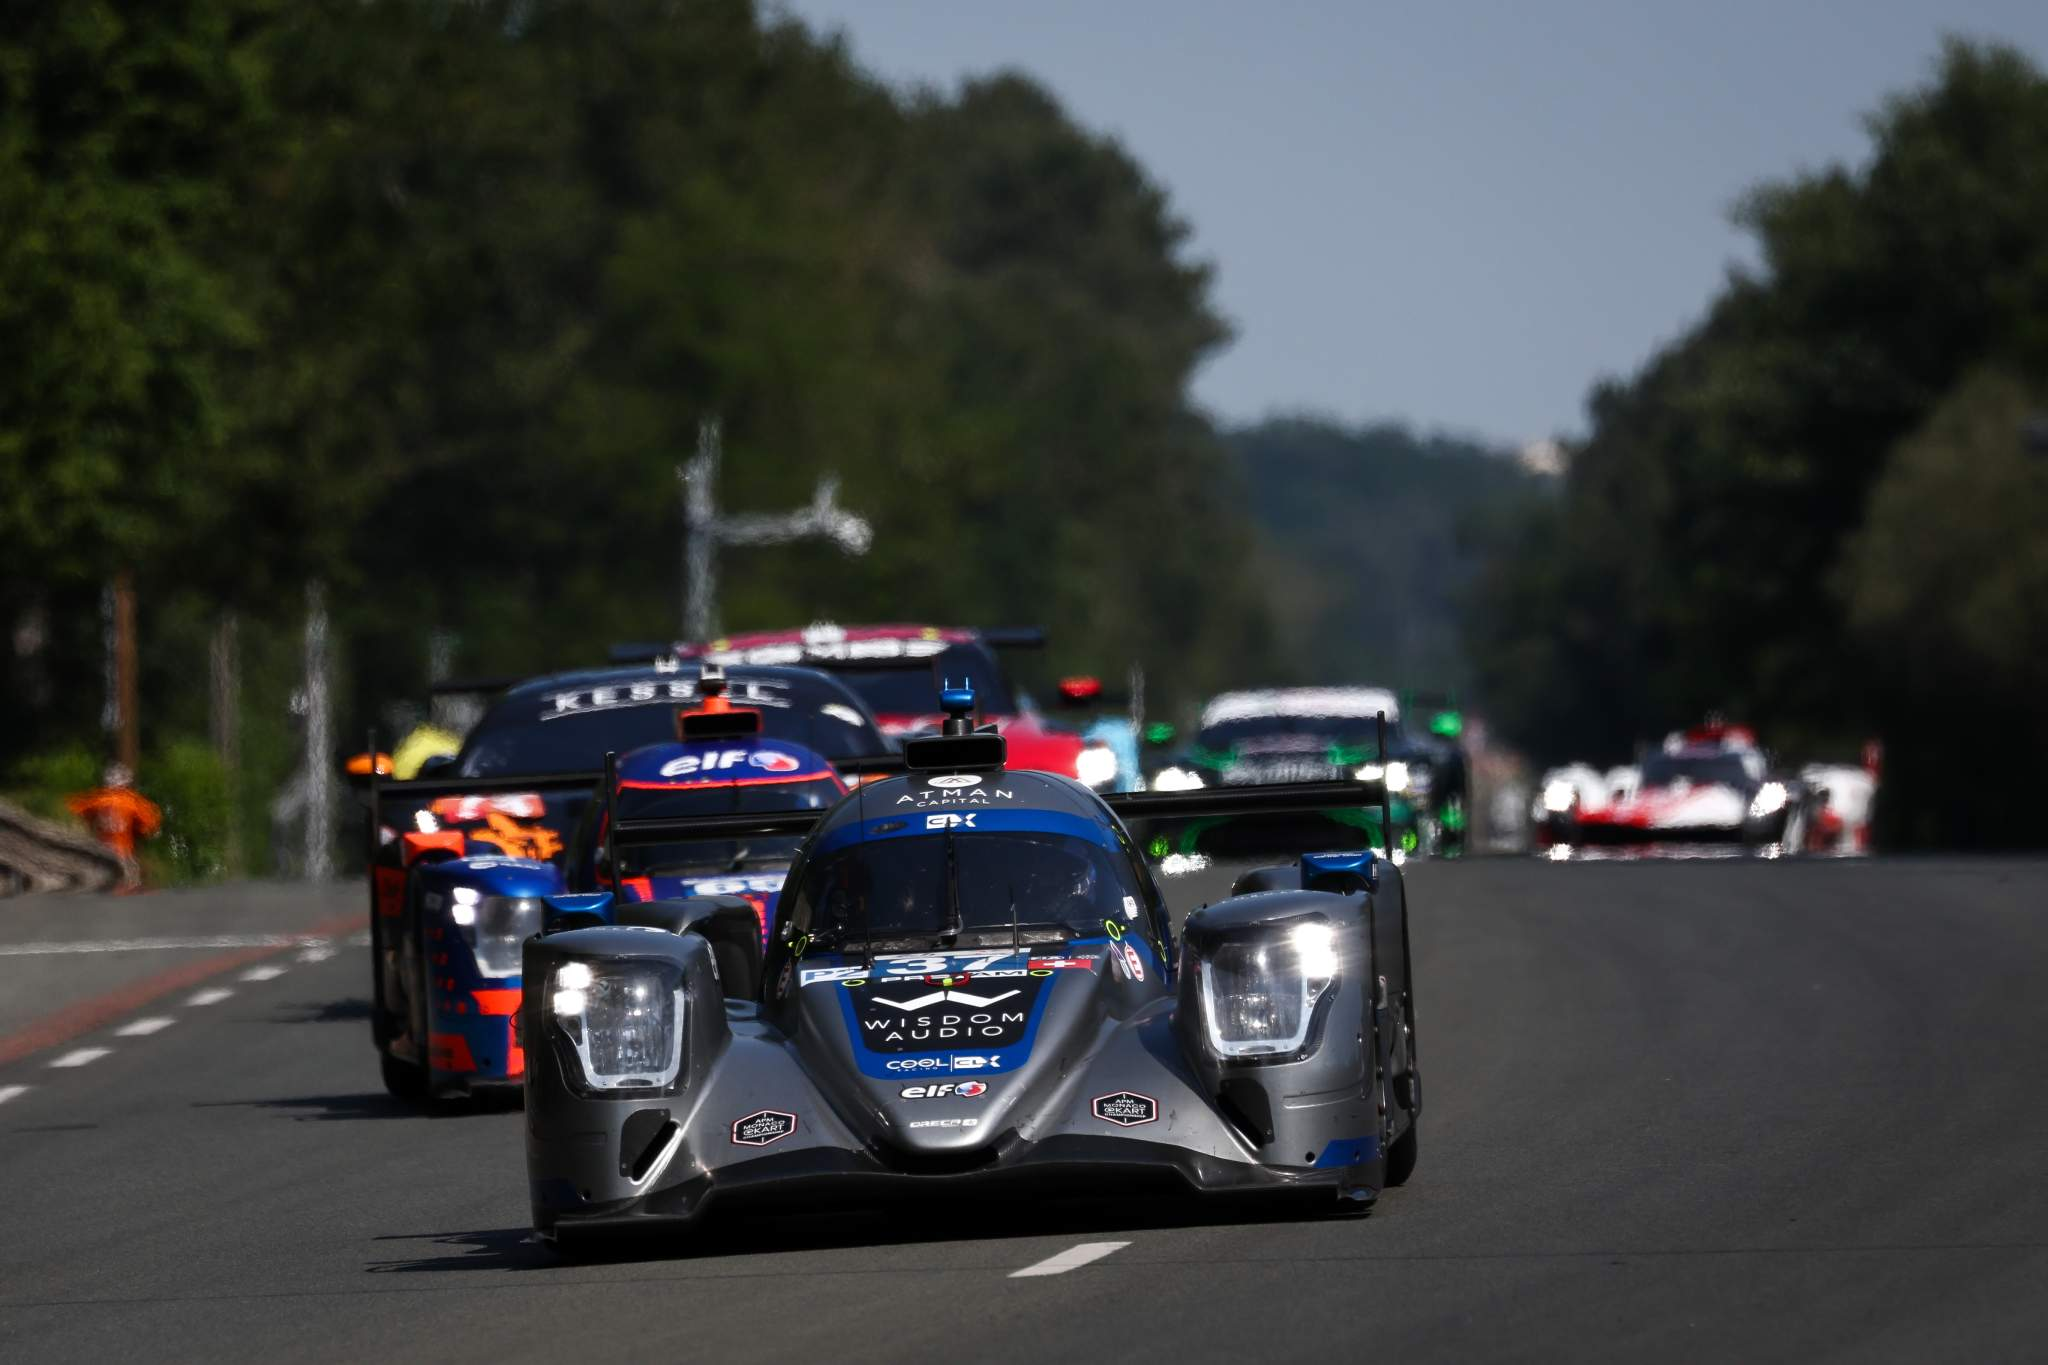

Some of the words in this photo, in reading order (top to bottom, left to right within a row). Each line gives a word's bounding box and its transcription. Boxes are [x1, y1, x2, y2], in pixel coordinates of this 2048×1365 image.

[555, 682, 774, 714] KESSL
[659, 749, 748, 777] elf
[896, 788, 1013, 805] ATMAN
[916, 798, 991, 808] CAPITAL
[886, 954, 1009, 974] 37
[865, 1012, 1025, 1030] WISDOM
[885, 1025, 1003, 1042] AUDIO
[886, 1057, 949, 1070] COOL
[900, 1083, 956, 1099] elf
[743, 1120, 786, 1130] MONACO
